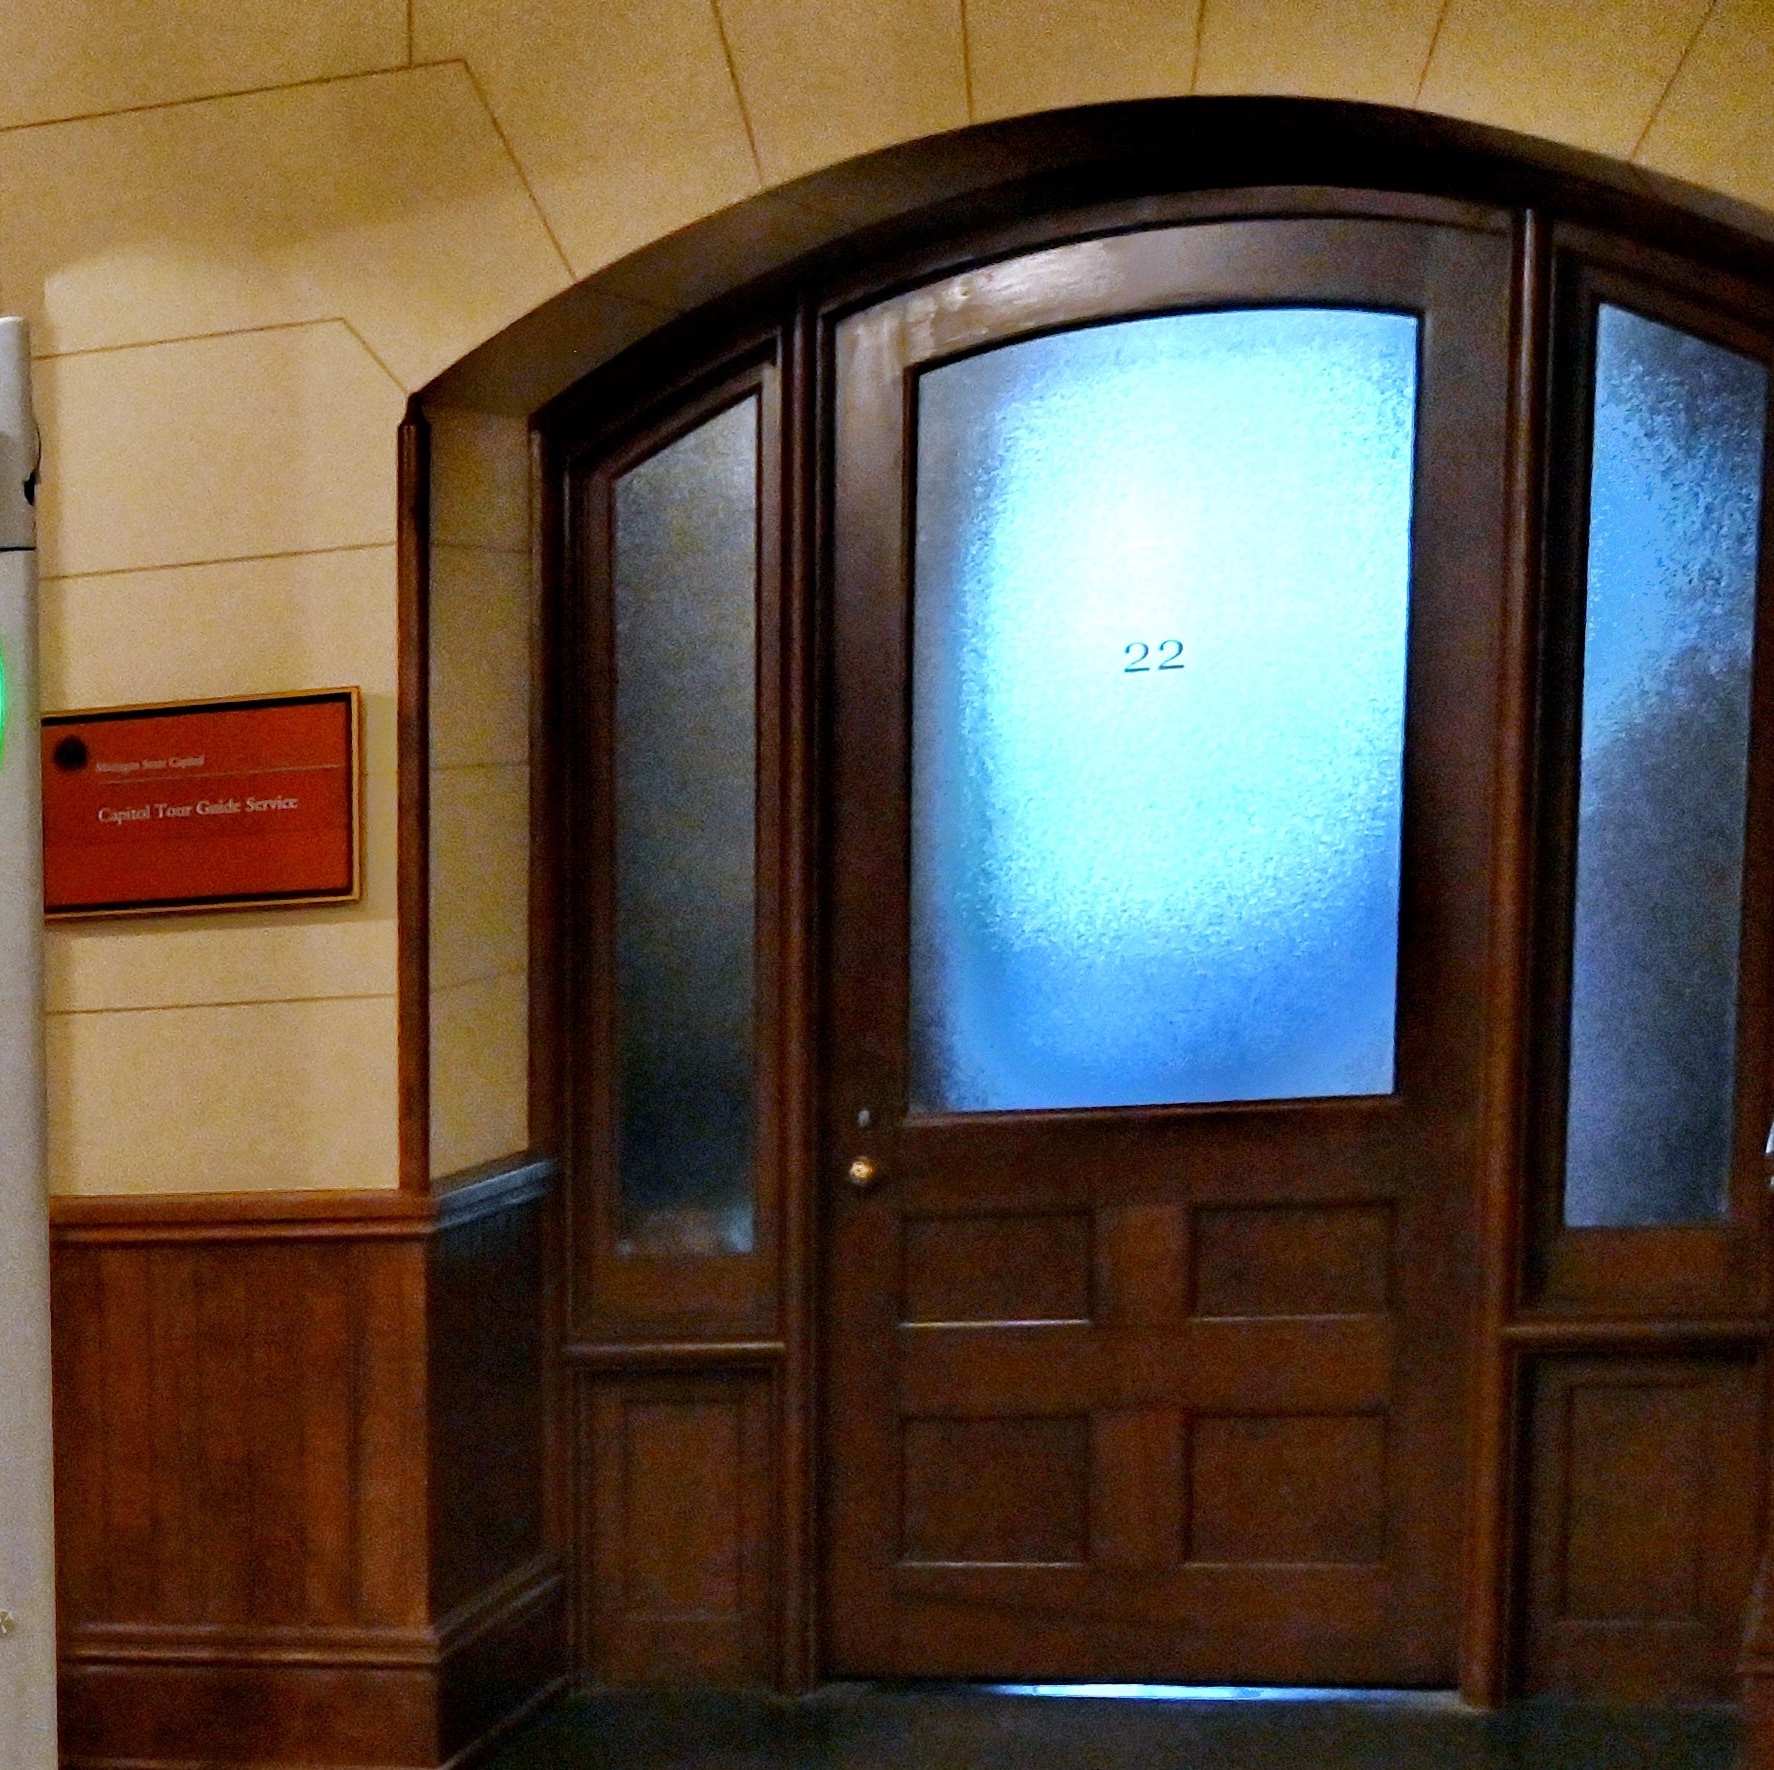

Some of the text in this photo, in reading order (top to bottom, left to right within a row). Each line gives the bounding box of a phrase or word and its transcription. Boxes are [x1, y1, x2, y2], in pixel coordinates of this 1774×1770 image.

[1123, 639, 1185, 673] 22
[98, 795, 298, 825] Capitol Tour Guide Service
